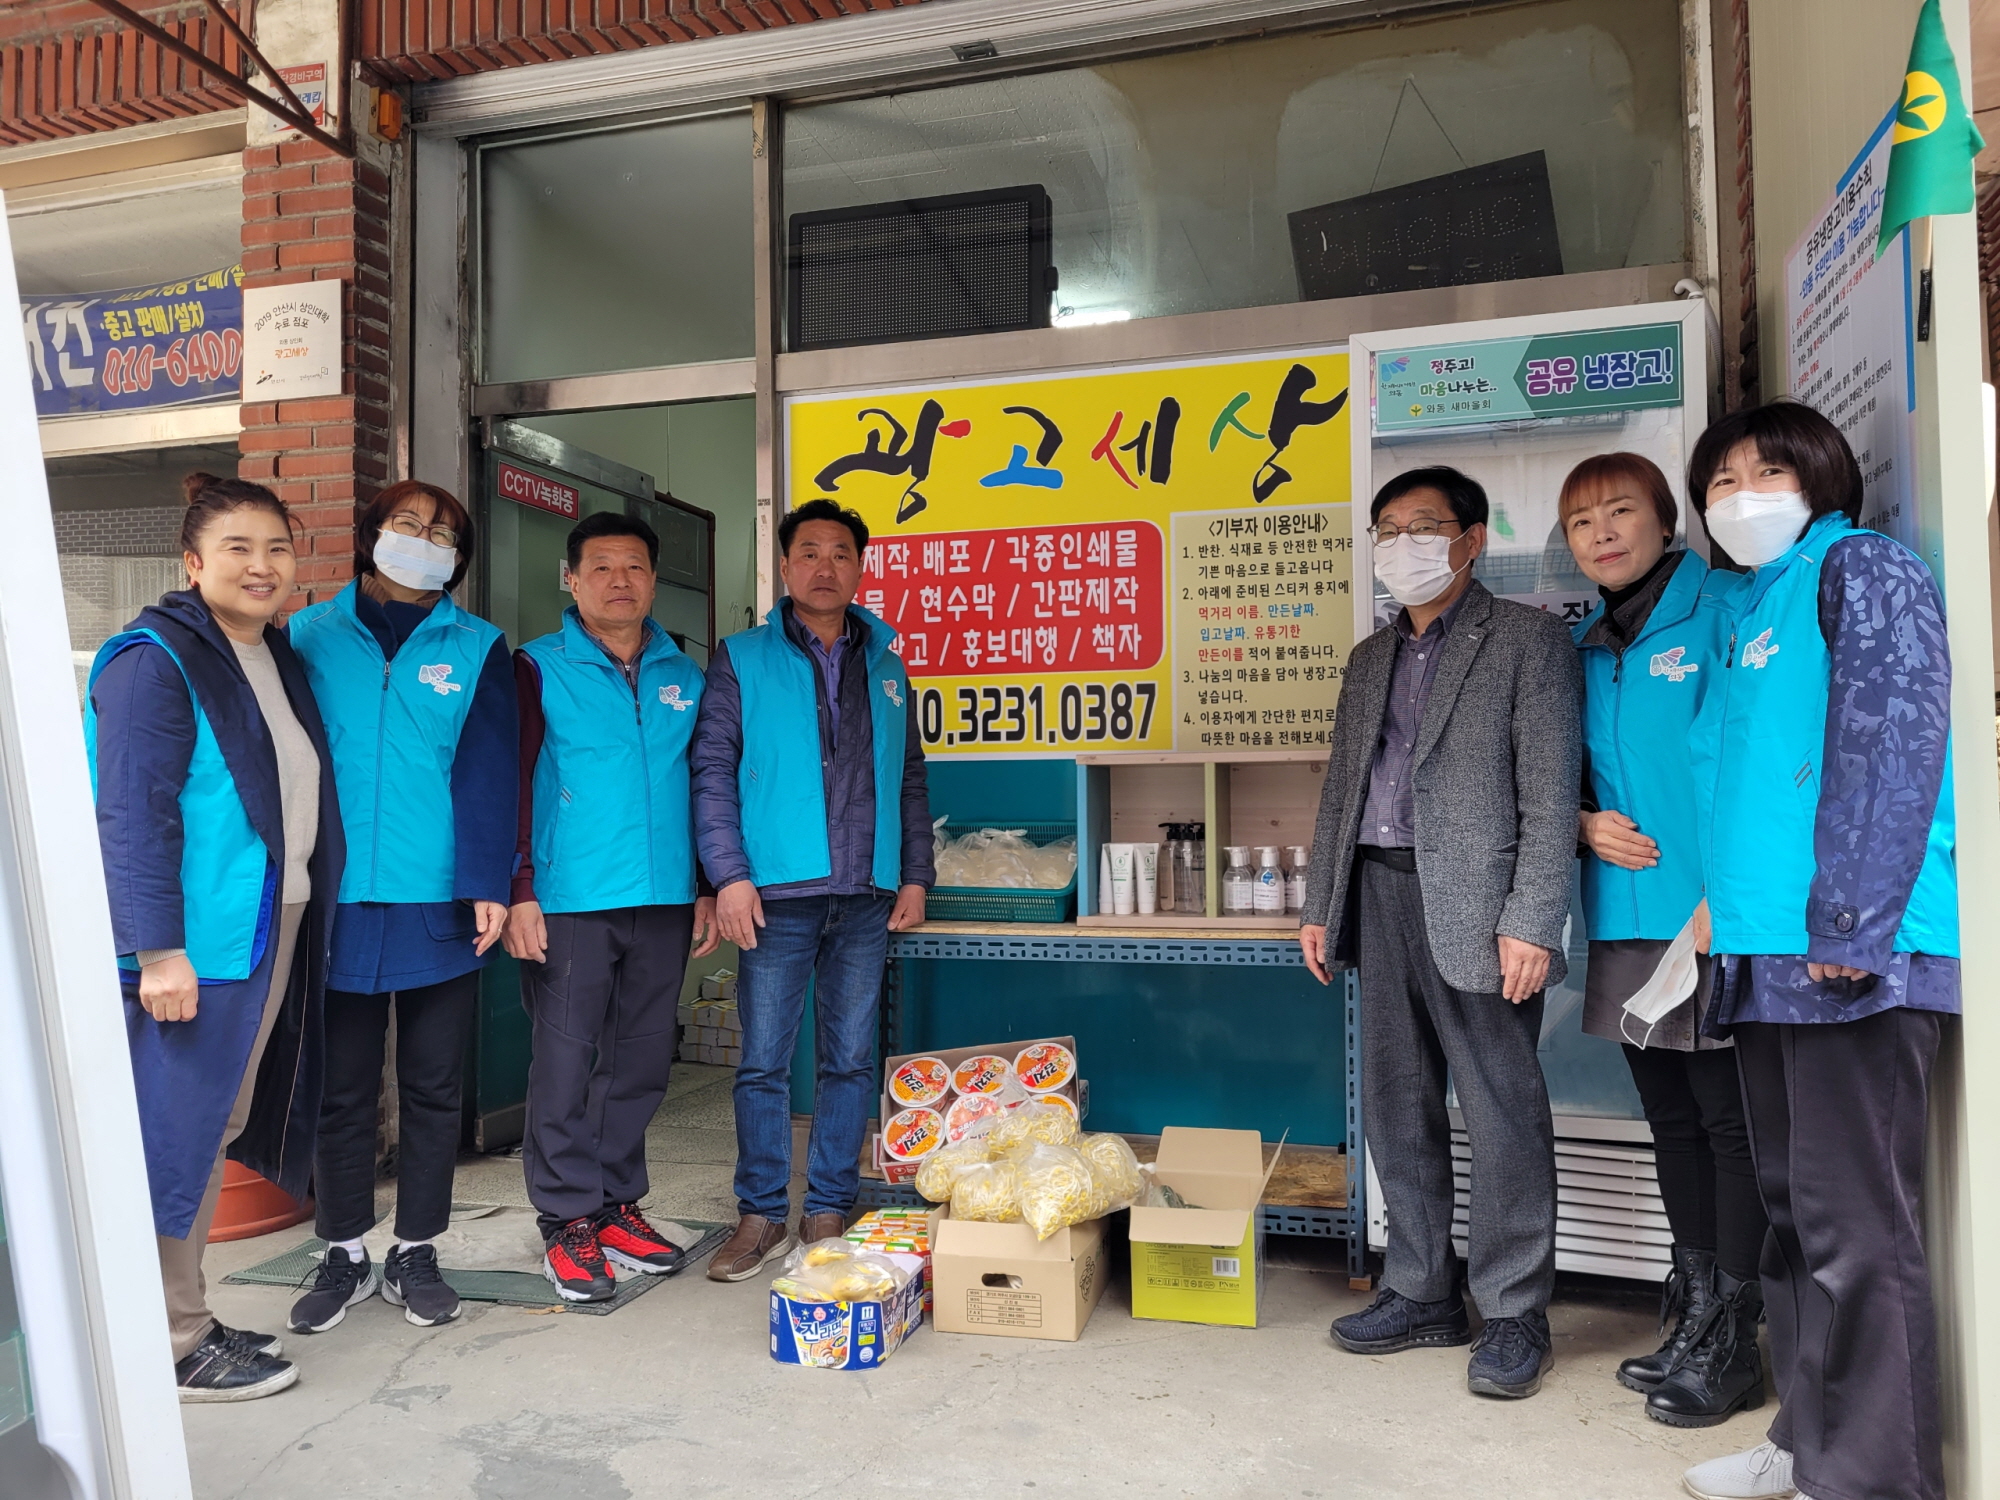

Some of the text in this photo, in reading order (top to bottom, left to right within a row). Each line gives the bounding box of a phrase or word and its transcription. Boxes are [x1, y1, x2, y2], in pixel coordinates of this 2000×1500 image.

[1806, 158, 1872, 266] 공유냉장고이용수칙
[1832, 230, 1845, 261] 이용
[103, 310, 136, 341] 중고
[134, 301, 205, 337] 판매/설치
[254, 301, 330, 332] 2019 안산시 상인대학
[274, 316, 310, 332] 수료 점포
[274, 346, 310, 359] 광고세상
[1430, 357, 1475, 375] 정주고!
[1526, 345, 1674, 397] 공유 냉장고!
[1420, 378, 1498, 397] 마음나누는..
[1426, 399, 1492, 414] 와동 새마을회
[813, 362, 1349, 525] 광고세상
[503, 469, 574, 515] CCTV녹화중
[1006, 529, 1138, 573] 각종인쇄물
[1182, 546, 1194, 559] 1.
[1198, 544, 1225, 559] 반찬.
[1229, 542, 1264, 557] 식재료
[1267, 540, 1278, 555] 등
[1282, 538, 1318, 555] 안전한
[1198, 559, 1334, 579] 기쁜 마음으로 들고옵니다
[919, 582, 996, 623] 현수막
[1031, 575, 1139, 618] 간판제작
[1182, 579, 1349, 600] 2. 아래에 준비된 스티커 용지에
[1198, 602, 1319, 620] 먹거리 이름. 만든날짜.
[1200, 624, 1301, 642] 입고날짜. 유통기한
[962, 625, 1058, 668] 홍보대행
[1092, 622, 1143, 663] 책자
[1198, 644, 1339, 663] 만든이를 적어 붙여줍니다.
[1183, 670, 1195, 683] 3.
[1199, 668, 1232, 683] 나눔의
[1237, 667, 1272, 682] 마음을
[1275, 667, 1299, 682] 담아
[1198, 689, 1248, 705] 넣습니다.
[1183, 708, 1336, 726] 4. 이용자에게 간단한 편지로
[1201, 731, 1236, 747] 따뜻한
[900, 1073, 925, 1093] 김치
[974, 1070, 997, 1090] 김치
[1033, 1062, 1058, 1084] 김치
[903, 1127, 929, 1152] 김치
[800, 1318, 842, 1343] 진라면
